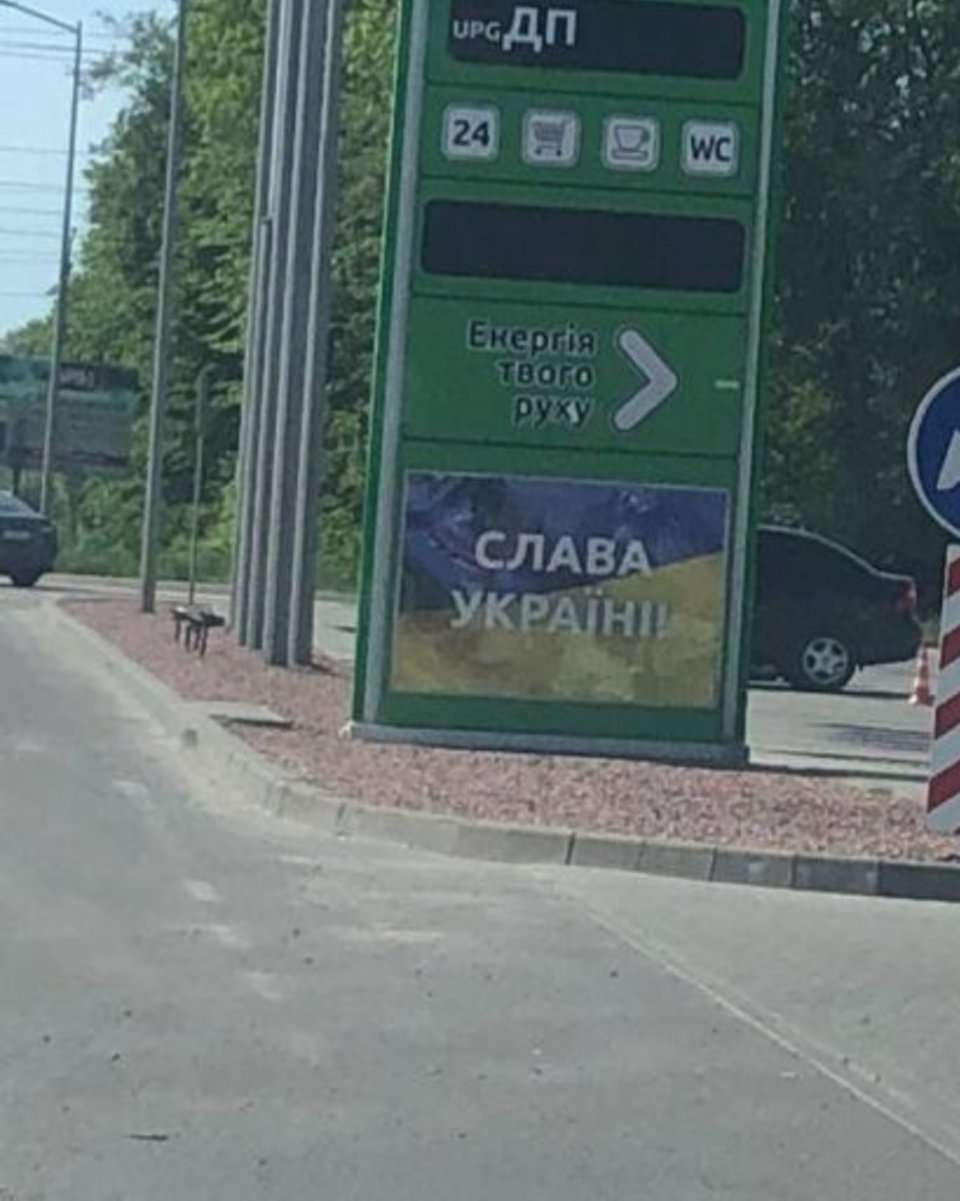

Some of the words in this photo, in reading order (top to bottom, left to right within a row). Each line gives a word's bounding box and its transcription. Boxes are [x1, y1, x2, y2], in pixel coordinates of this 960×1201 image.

[452, 119, 491, 147] 24
[690, 135, 733, 163] WC
[498, 359, 593, 387] твого
[513, 397, 592, 428] руху
[475, 530, 651, 576] СЛАВА
